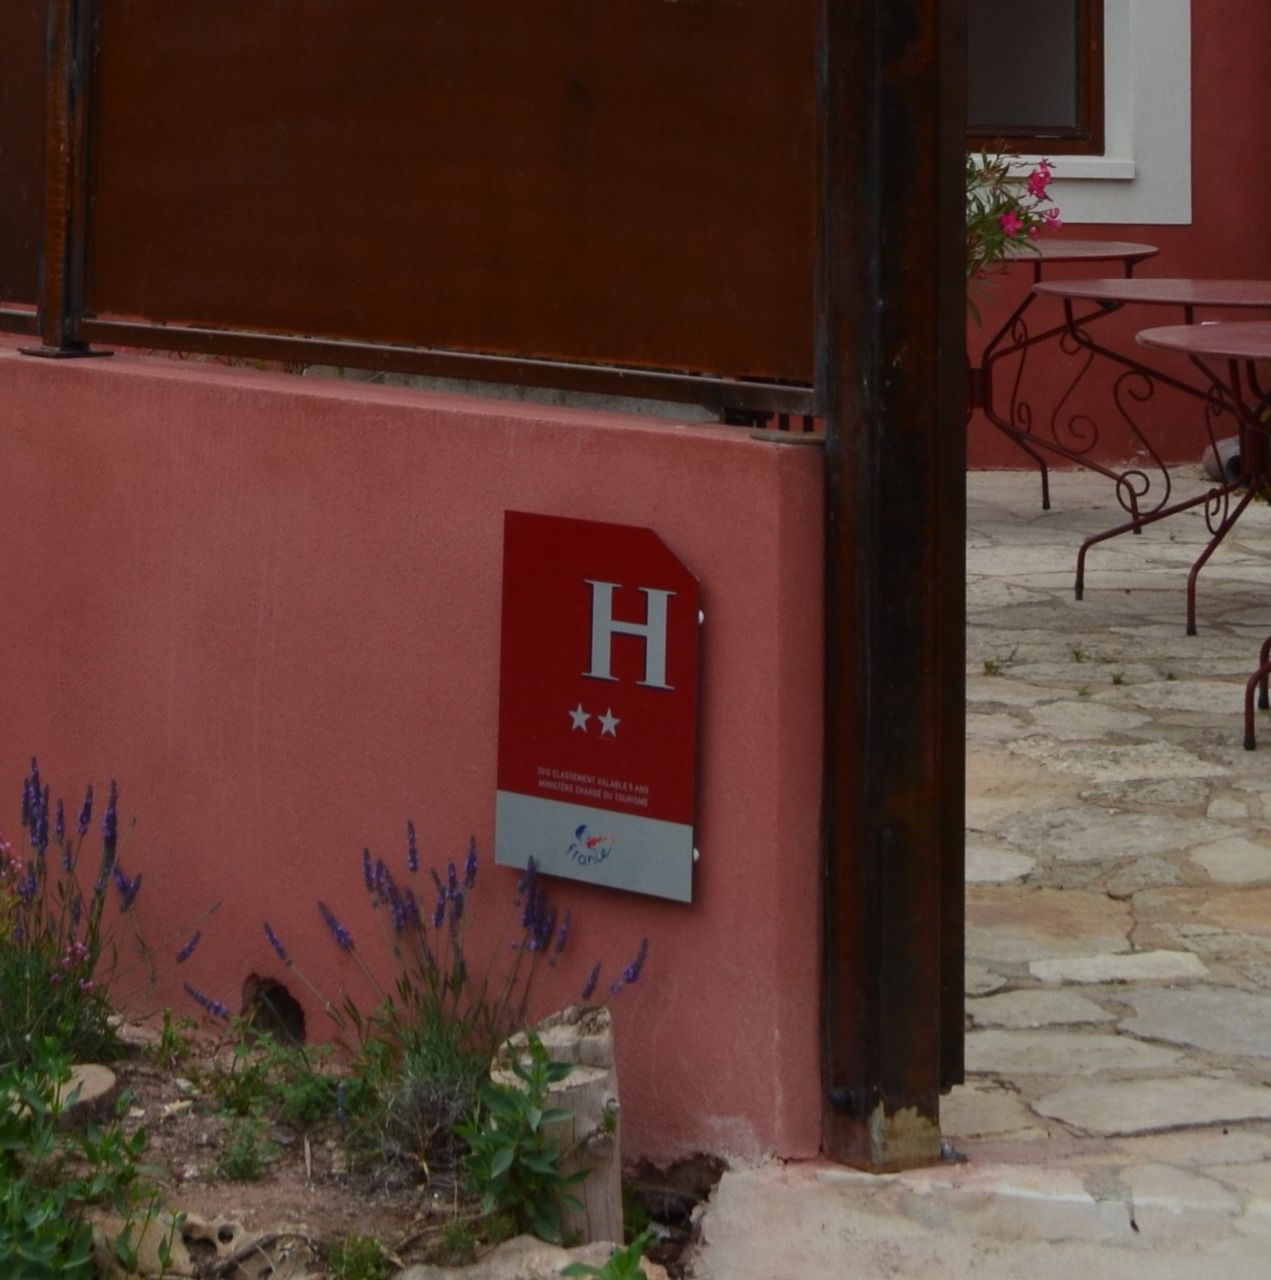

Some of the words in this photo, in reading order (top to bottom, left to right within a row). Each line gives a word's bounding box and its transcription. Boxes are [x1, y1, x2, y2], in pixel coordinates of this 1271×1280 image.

[581, 579, 677, 690] H
[551, 769, 596, 785] CLASSEMENT
[597, 776, 628, 791] VALABLE
[634, 783, 649, 794] ANS
[603, 790, 613, 800] DU
[614, 791, 649, 807] TOURISME
